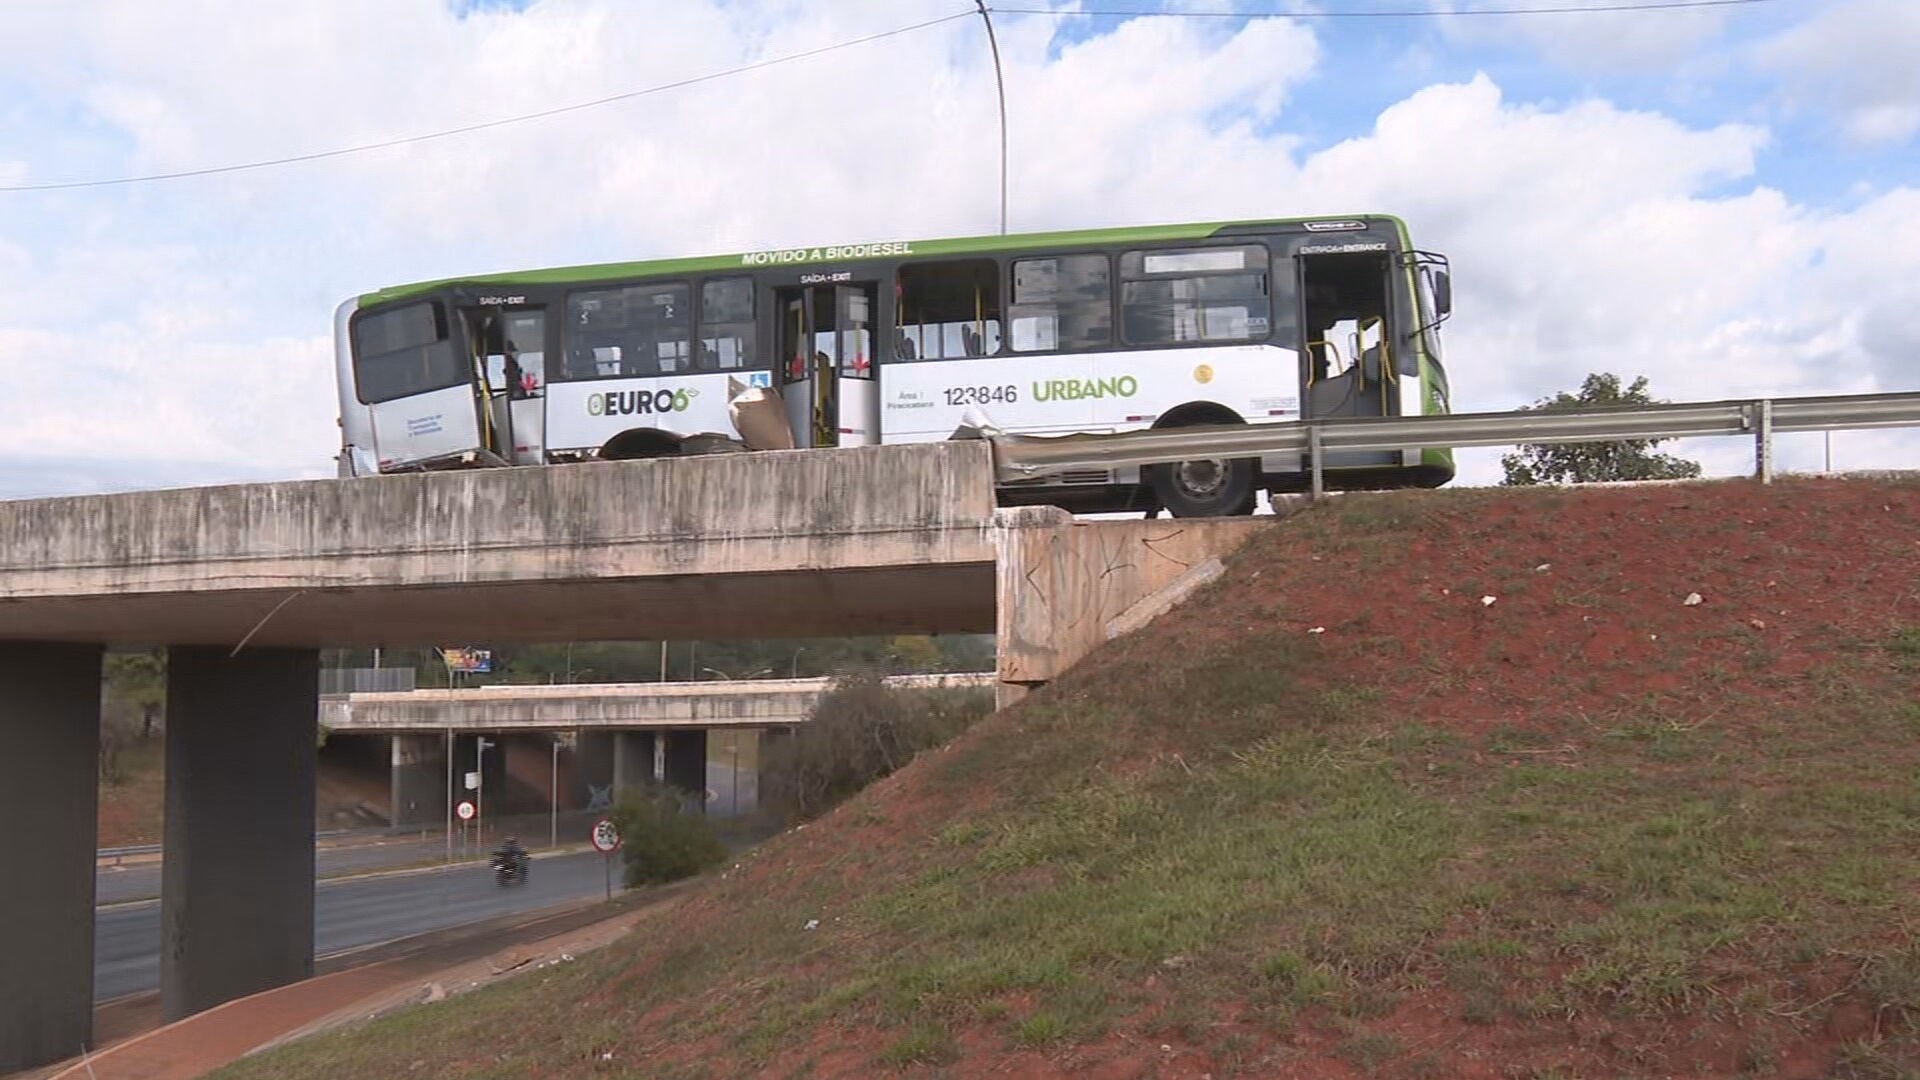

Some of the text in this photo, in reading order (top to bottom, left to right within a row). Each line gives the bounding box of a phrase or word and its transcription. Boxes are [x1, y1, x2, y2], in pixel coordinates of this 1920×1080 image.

[742, 242, 913, 265] MOVIDO A BIODIESEL
[943, 384, 1018, 406] 123846
[1032, 375, 1138, 402] URBANO
